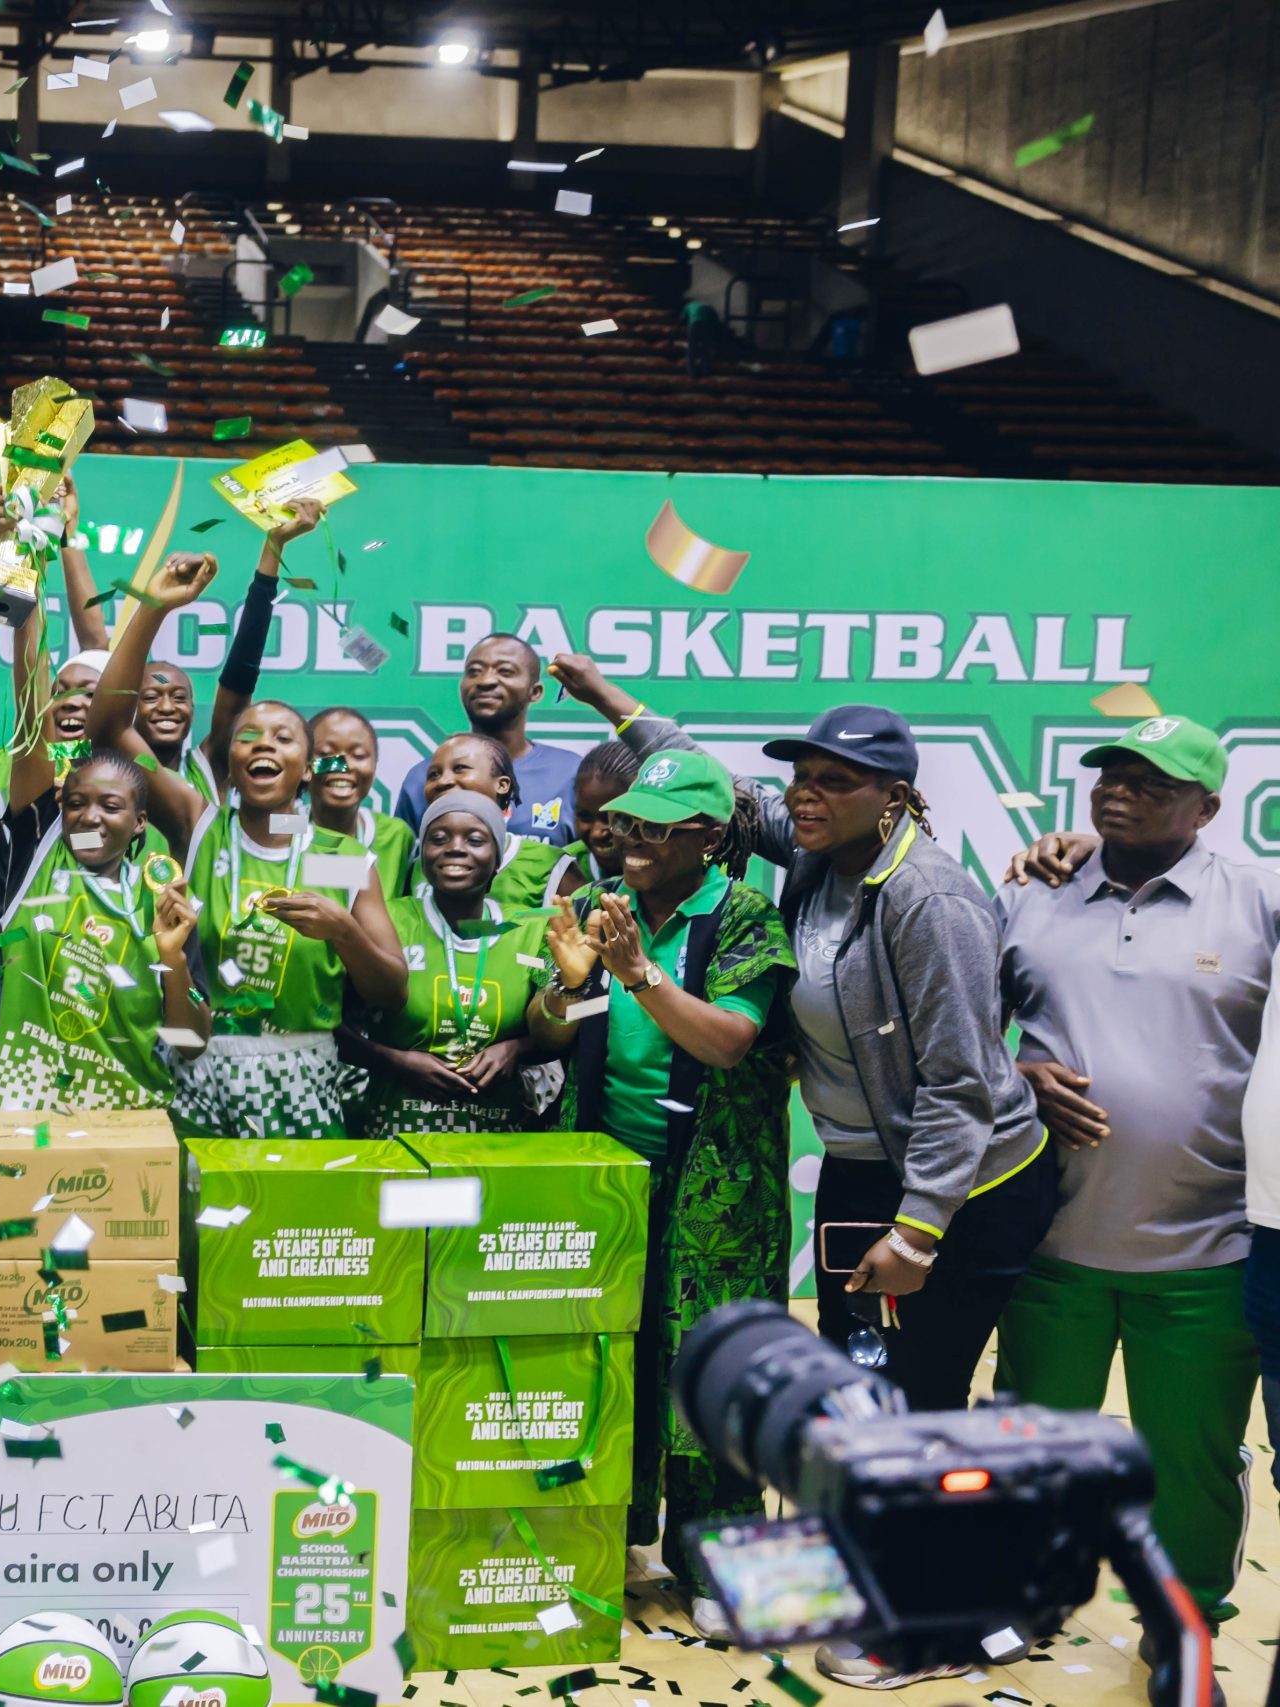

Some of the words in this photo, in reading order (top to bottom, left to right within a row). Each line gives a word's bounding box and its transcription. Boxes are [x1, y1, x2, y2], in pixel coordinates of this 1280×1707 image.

[420, 604, 1151, 684] BASKETBALL
[235, 942, 273, 974] 25
[56, 1174, 107, 1193] MILO
[301, 1228, 322, 1237] THAN
[526, 1222, 547, 1231] THAN
[252, 1239, 271, 1258] 25
[273, 1238, 320, 1258] YEARS
[322, 1238, 340, 1257] OF
[342, 1237, 375, 1257] GRIT
[478, 1233, 497, 1252] 25
[498, 1232, 544, 1252] YEARS
[545, 1232, 564, 1251] OF
[566, 1231, 598, 1250] GRIT
[258, 1259, 289, 1278] AND
[290, 1257, 370, 1277] GREATNESS
[483, 1252, 513, 1271] AND
[514, 1250, 591, 1271] GREATNESS
[242, 1297, 282, 1308] NATIONAL
[283, 1296, 344, 1307] CHAMPIONSHIP
[346, 1294, 384, 1306] WINNERS
[468, 1290, 506, 1302] NATIONAL
[506, 1288, 566, 1300] CHAMPIONSHIP
[566, 1287, 603, 1299] WINNERS
[465, 1402, 483, 1421] 25
[532, 1401, 551, 1420] OF
[552, 1401, 585, 1420] GRIT
[471, 1421, 500, 1441] AND
[502, 1420, 579, 1440] GREATNESS
[455, 1459, 495, 1471] NATIONAL
[301, 1511, 351, 1529] MILO
[300, 1544, 348, 1554] SCHOOL
[93, 1549, 174, 1592] only
[281, 1556, 354, 1566] BASKETBA
[276, 1567, 369, 1578] CHAMPIONSHIP
[458, 1569, 477, 1587] 25
[478, 1567, 524, 1586] YEARS
[525, 1566, 543, 1584] OF
[294, 1582, 351, 1625] 25
[353, 1591, 368, 1602] TH
[464, 1586, 493, 1605] AND
[494, 1583, 570, 1604] GREATNESS
[277, 1629, 365, 1644] ANNIVERSARY
[449, 1623, 487, 1635] NATIONAL
[42, 1663, 87, 1681] MILO
